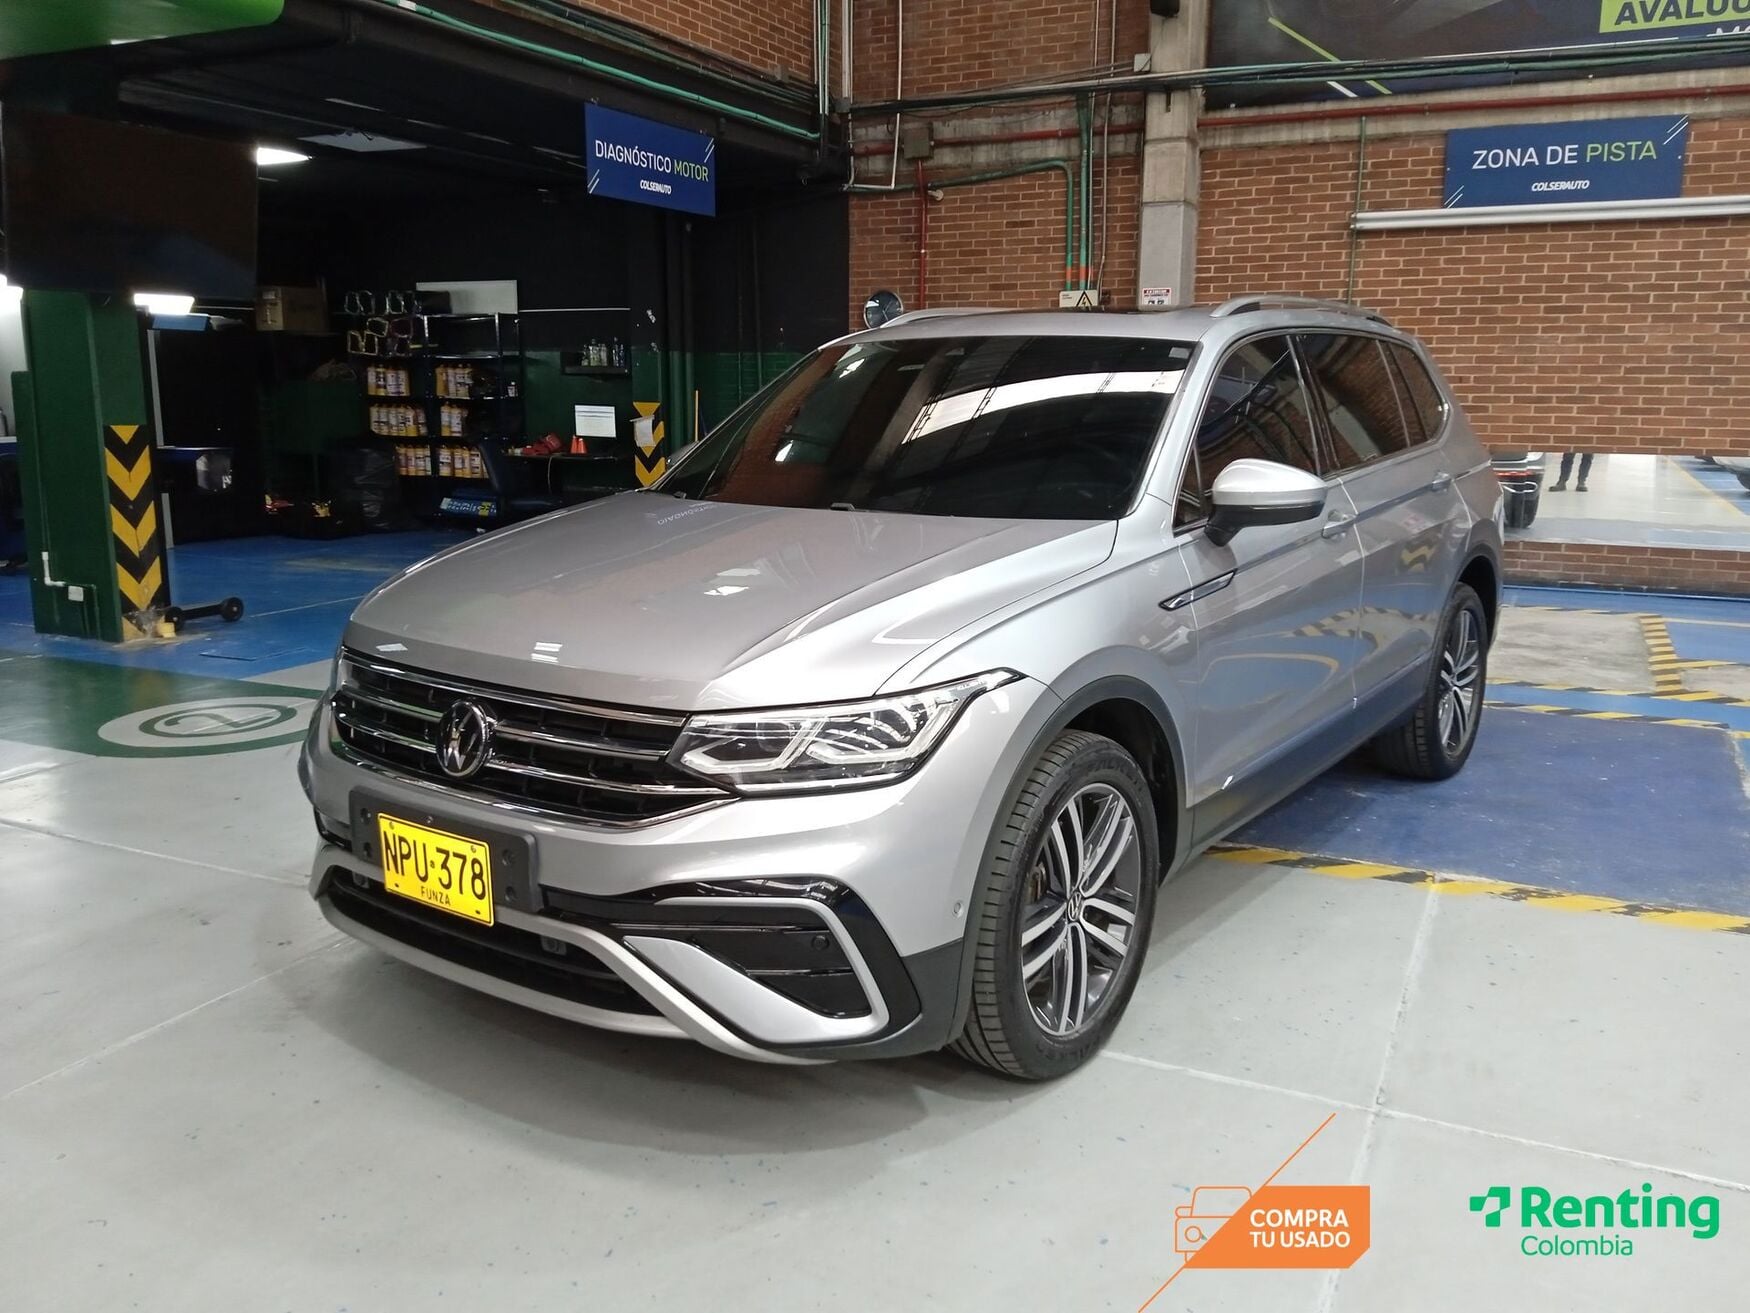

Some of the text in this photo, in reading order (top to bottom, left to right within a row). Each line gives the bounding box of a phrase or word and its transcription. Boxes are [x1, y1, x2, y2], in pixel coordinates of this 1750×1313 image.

[595, 139, 709, 182] DIAGNÓSTICO MOTOR
[1472, 140, 1657, 169] ZONA DE PISTA
[1531, 179, 1590, 192] COLSERAUTO
[420, 886, 451, 906] FUNZA
